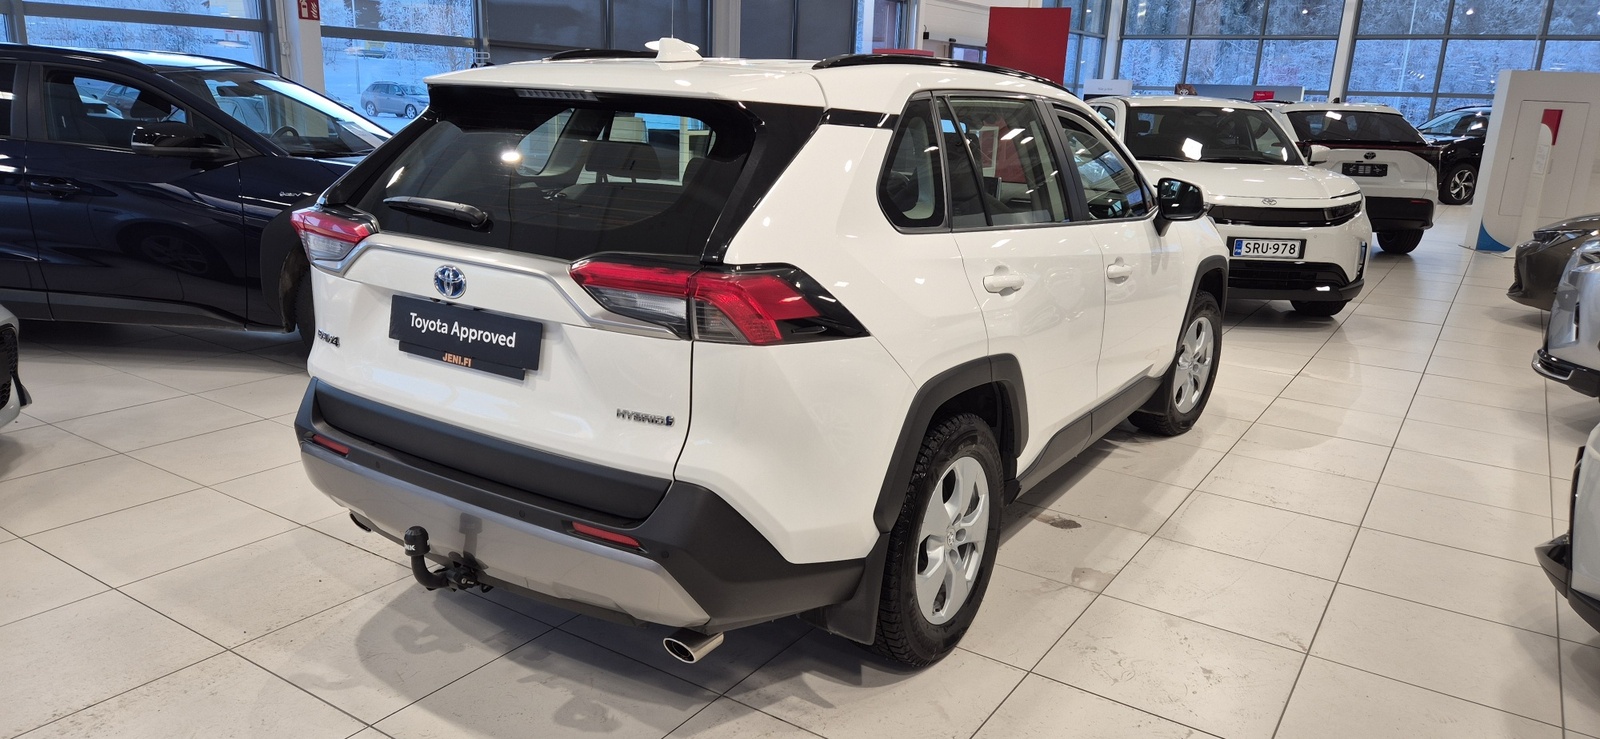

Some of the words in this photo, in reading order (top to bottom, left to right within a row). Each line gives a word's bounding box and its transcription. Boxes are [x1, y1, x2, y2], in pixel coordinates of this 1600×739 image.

[410, 312, 448, 333] Toyota
[450, 321, 516, 348] Approved
[442, 353, 472, 367] JENI.FI
